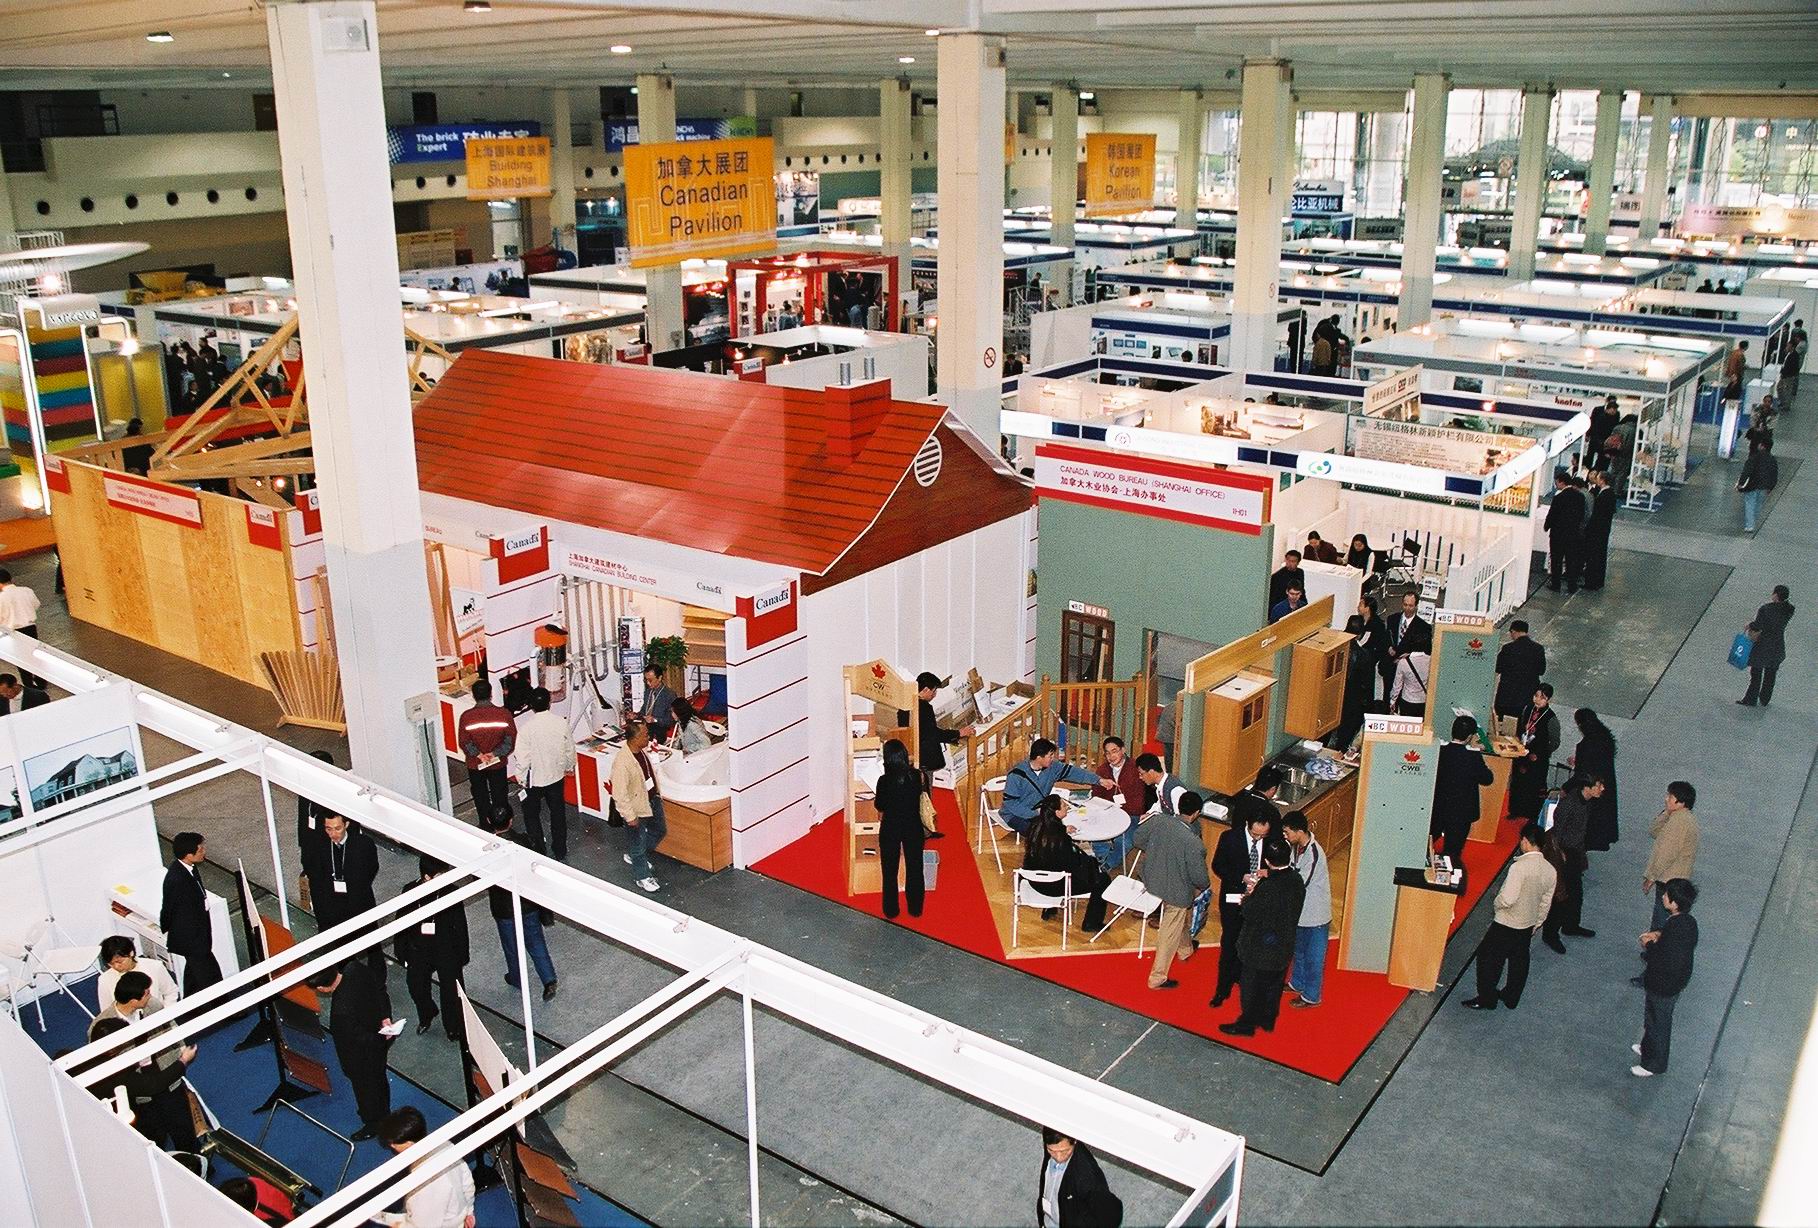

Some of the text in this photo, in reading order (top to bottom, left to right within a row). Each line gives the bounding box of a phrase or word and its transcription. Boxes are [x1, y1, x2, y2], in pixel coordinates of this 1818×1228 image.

[416, 133, 435, 142] The
[435, 132, 459, 141] brick
[417, 143, 447, 152] Expert
[489, 160, 533, 171] Building
[657, 151, 749, 180] 加拿大展团
[1109, 163, 1141, 178] Korean
[487, 176, 537, 188] Shanghai
[660, 181, 748, 206] Canadian
[1105, 184, 1142, 200] Pavilion
[670, 213, 743, 236] Pavilion
[1059, 465, 1226, 500] CANADA WOOD BUREAU (SHANGHAI OFFICE)
[506, 533, 539, 551] Canada
[568, 561, 657, 585] SHANGHAI CANADIAN BUILDING CENTER
[696, 581, 722, 594] Canada
[756, 588, 789, 610] Canada
[1085, 605, 1108, 617] WOOD
[1455, 615, 1483, 625] WOOD
[1373, 722, 1421, 734] BC WOOD
